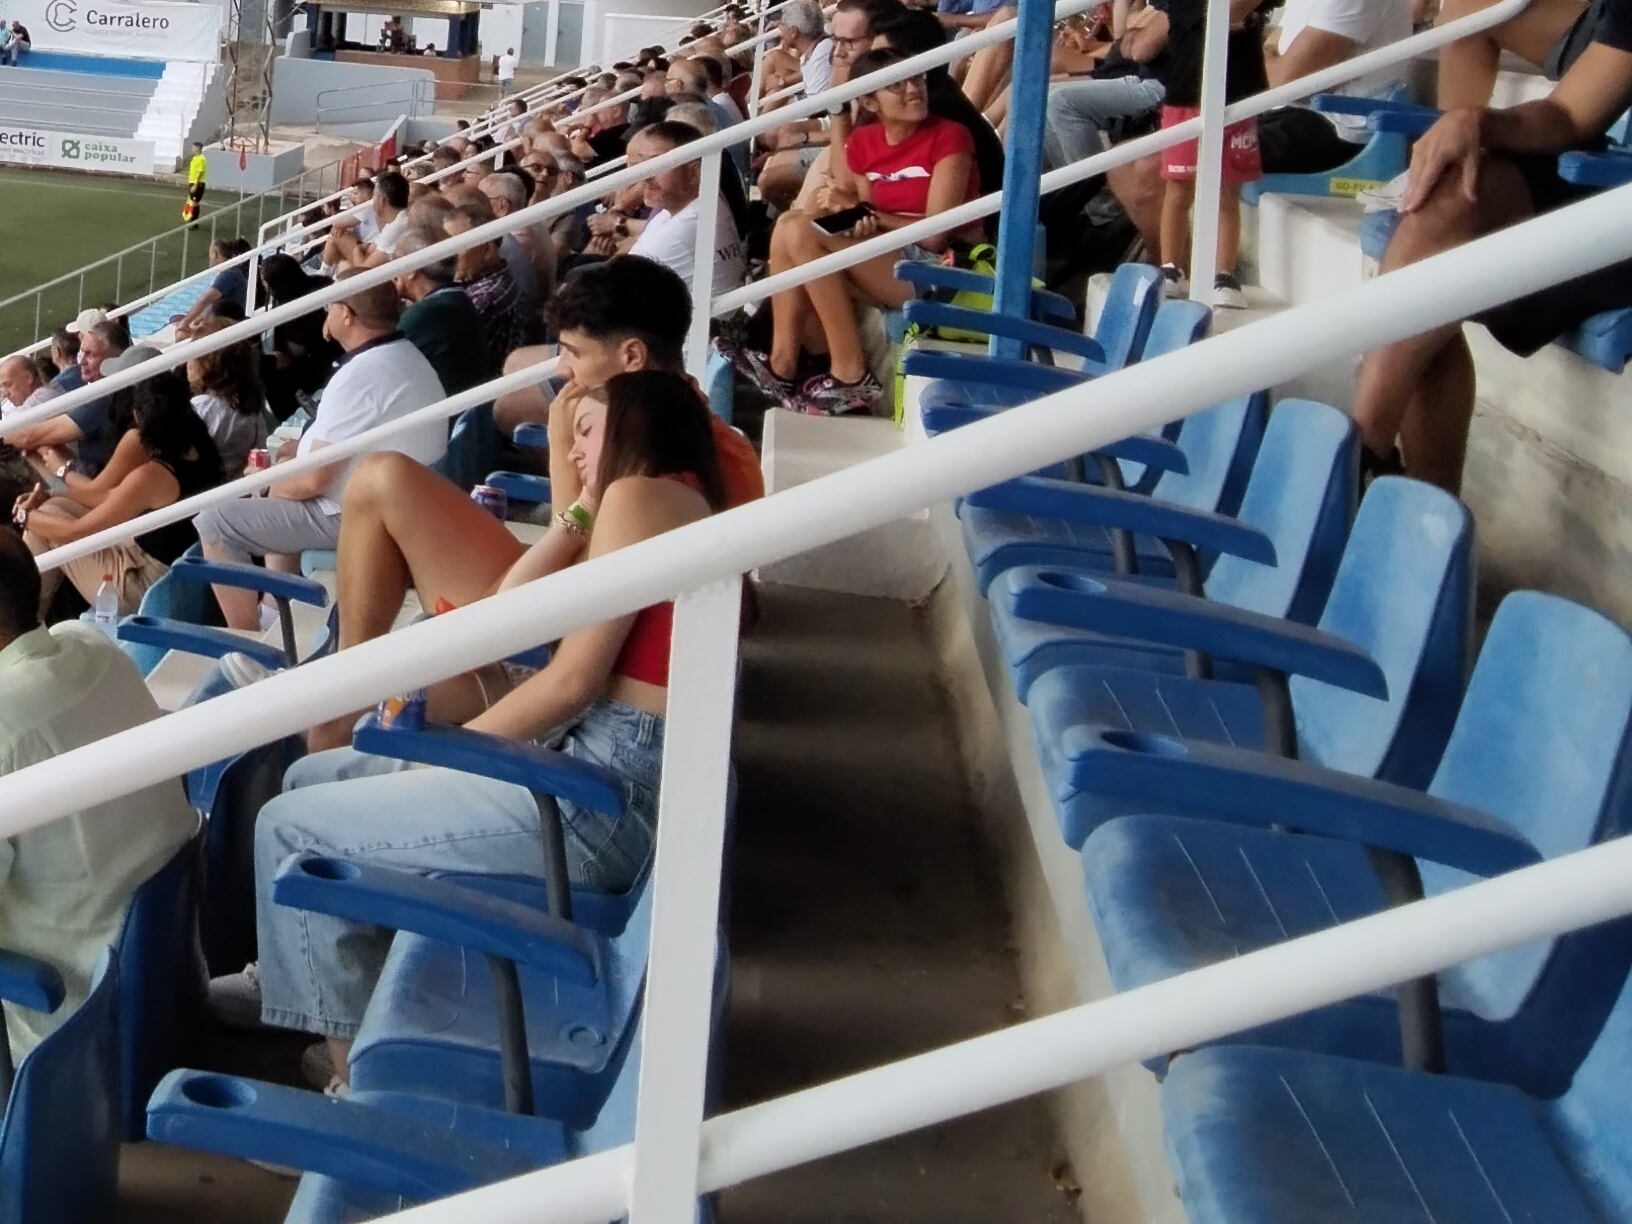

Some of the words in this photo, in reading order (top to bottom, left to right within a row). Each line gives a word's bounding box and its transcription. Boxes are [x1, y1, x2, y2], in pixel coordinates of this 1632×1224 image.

[86, 9, 170, 29] Carralero
[84, 142, 118, 153] caixa
[84, 151, 136, 163] popular
